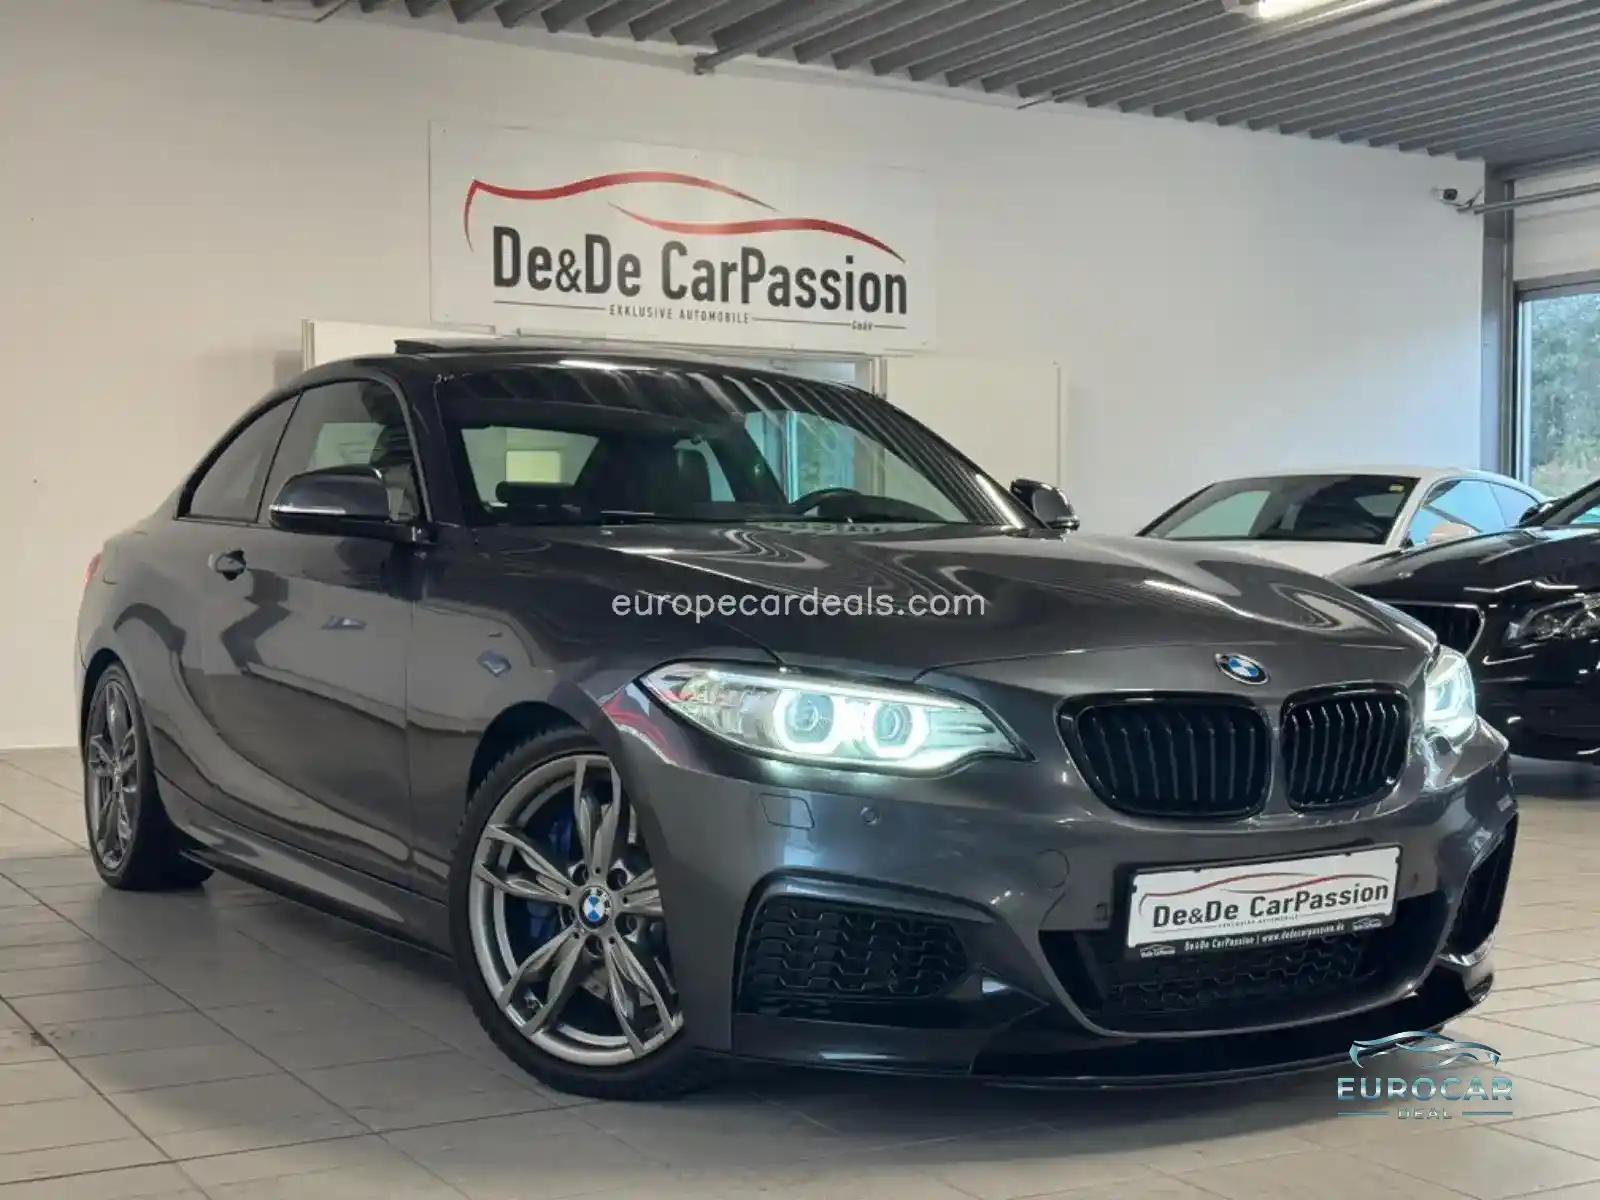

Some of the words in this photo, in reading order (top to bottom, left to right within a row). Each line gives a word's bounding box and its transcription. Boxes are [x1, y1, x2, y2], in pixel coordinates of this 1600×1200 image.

[493, 226, 641, 297] De&De
[660, 241, 908, 315] CarPassion
[609, 304, 673, 320] EXKLUSIVE
[679, 309, 750, 324] AUTOMOBILE
[1152, 900, 1240, 928] De&De
[1250, 883, 1390, 918] CarPassion
